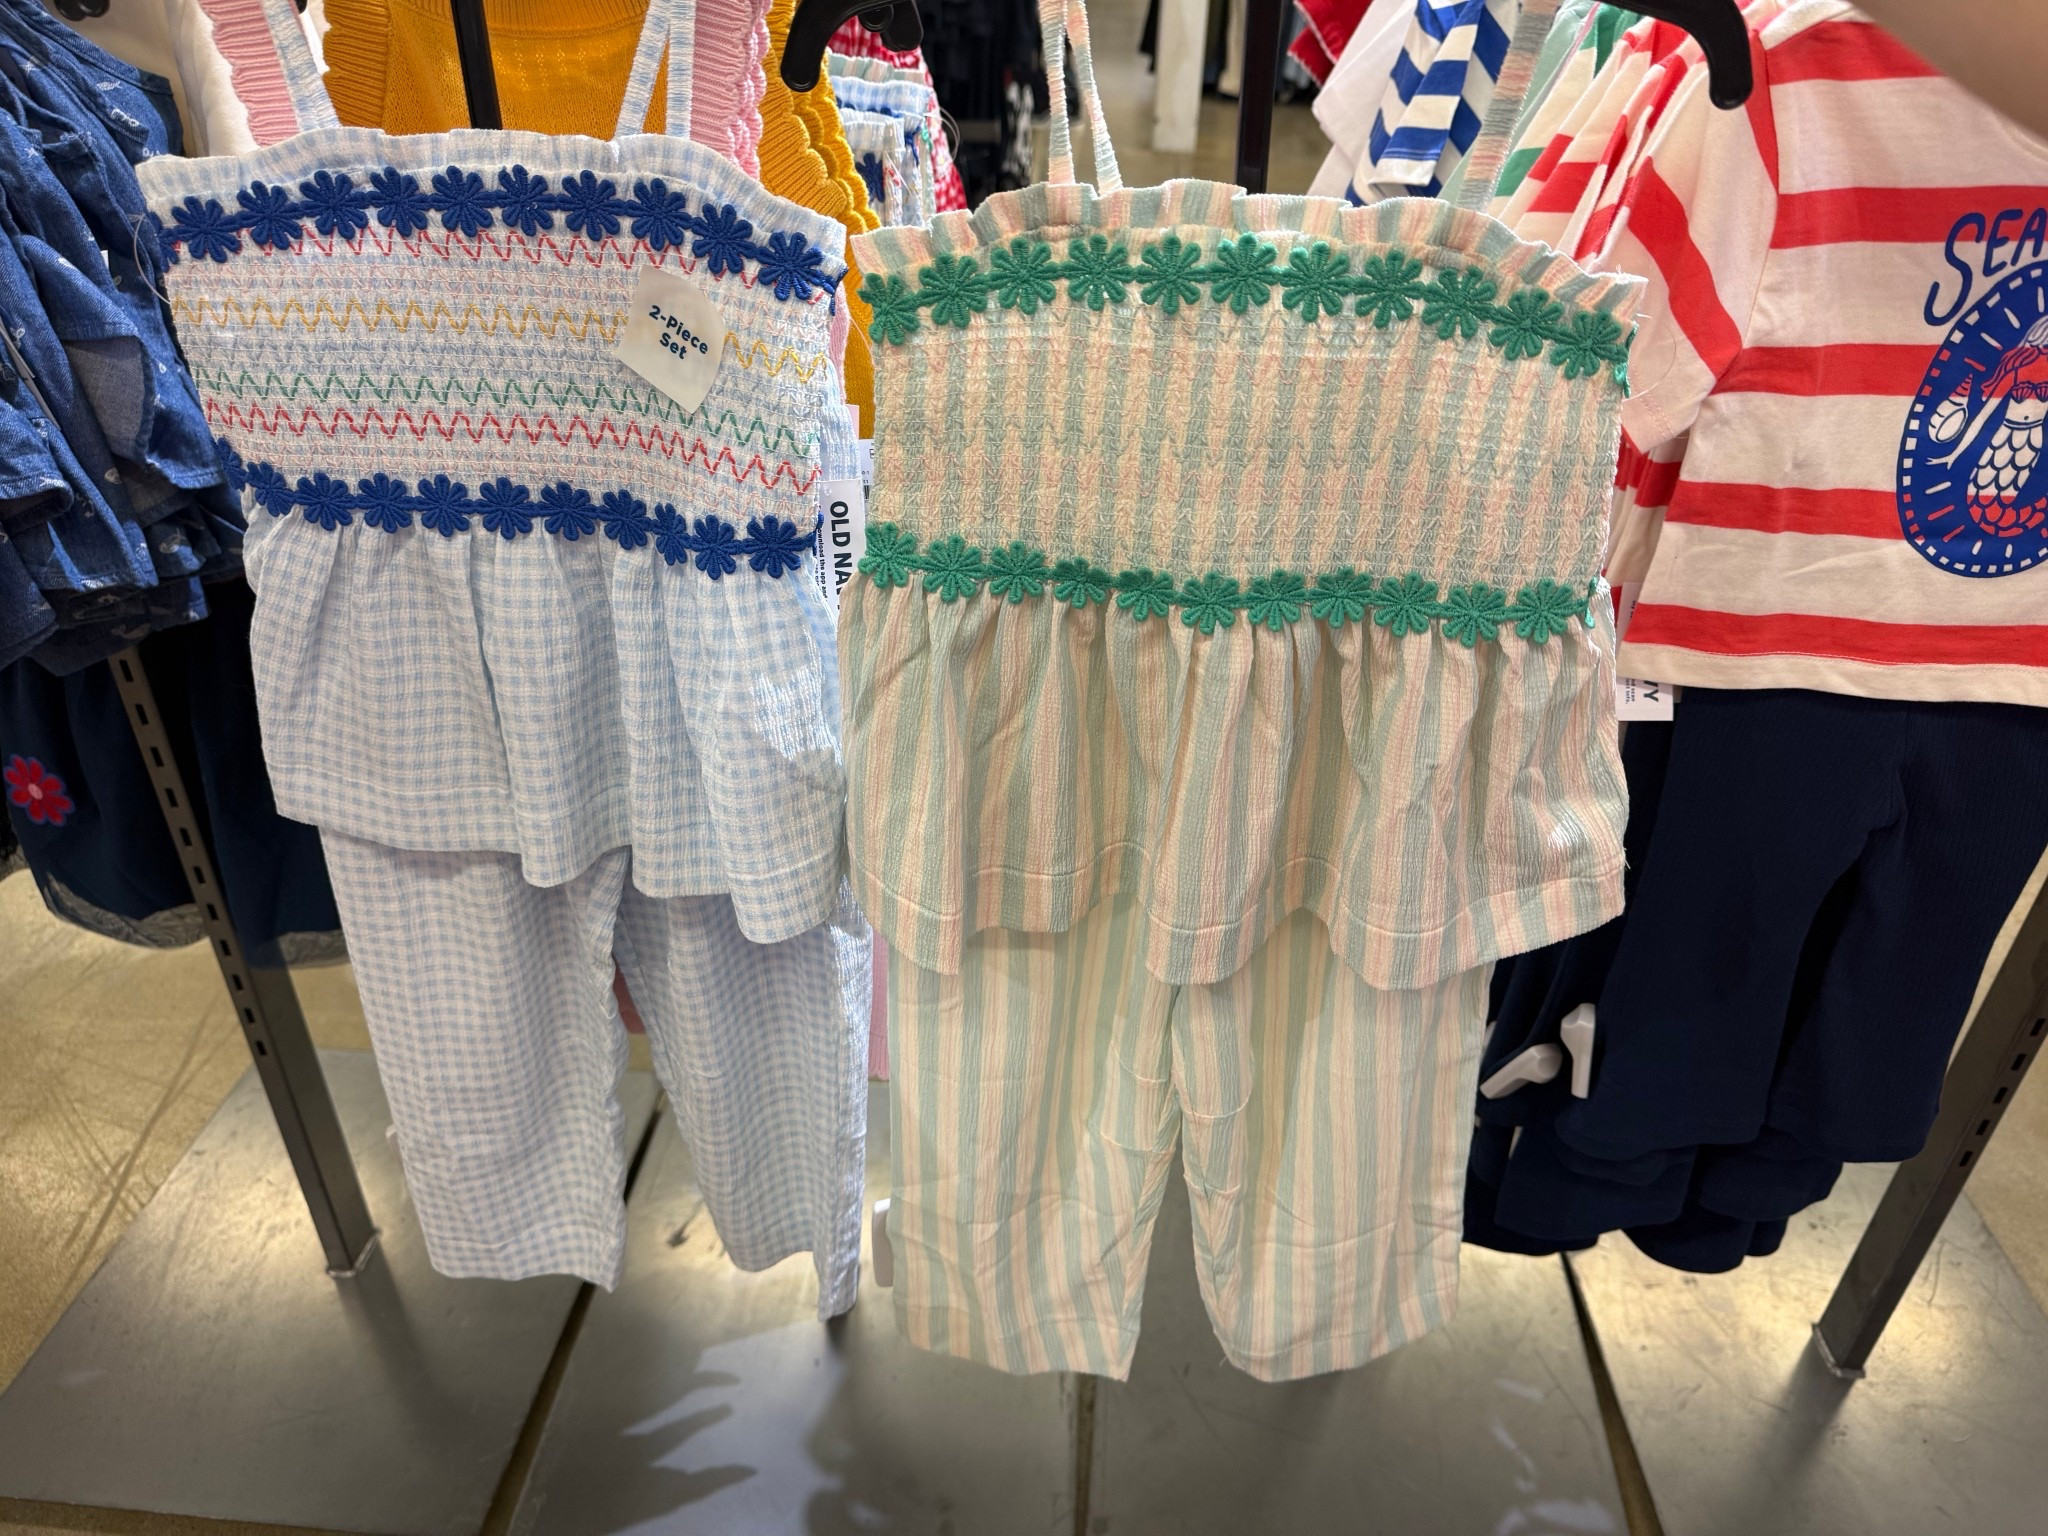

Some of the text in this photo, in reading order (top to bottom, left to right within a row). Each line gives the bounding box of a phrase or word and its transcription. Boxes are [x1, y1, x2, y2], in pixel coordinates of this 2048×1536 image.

[1924, 207, 2048, 326] SEA
[649, 305, 708, 354] 2-Piece
[660, 332, 688, 360] Set
[817, 526, 825, 557] ownload
[830, 501, 850, 547] OLD
